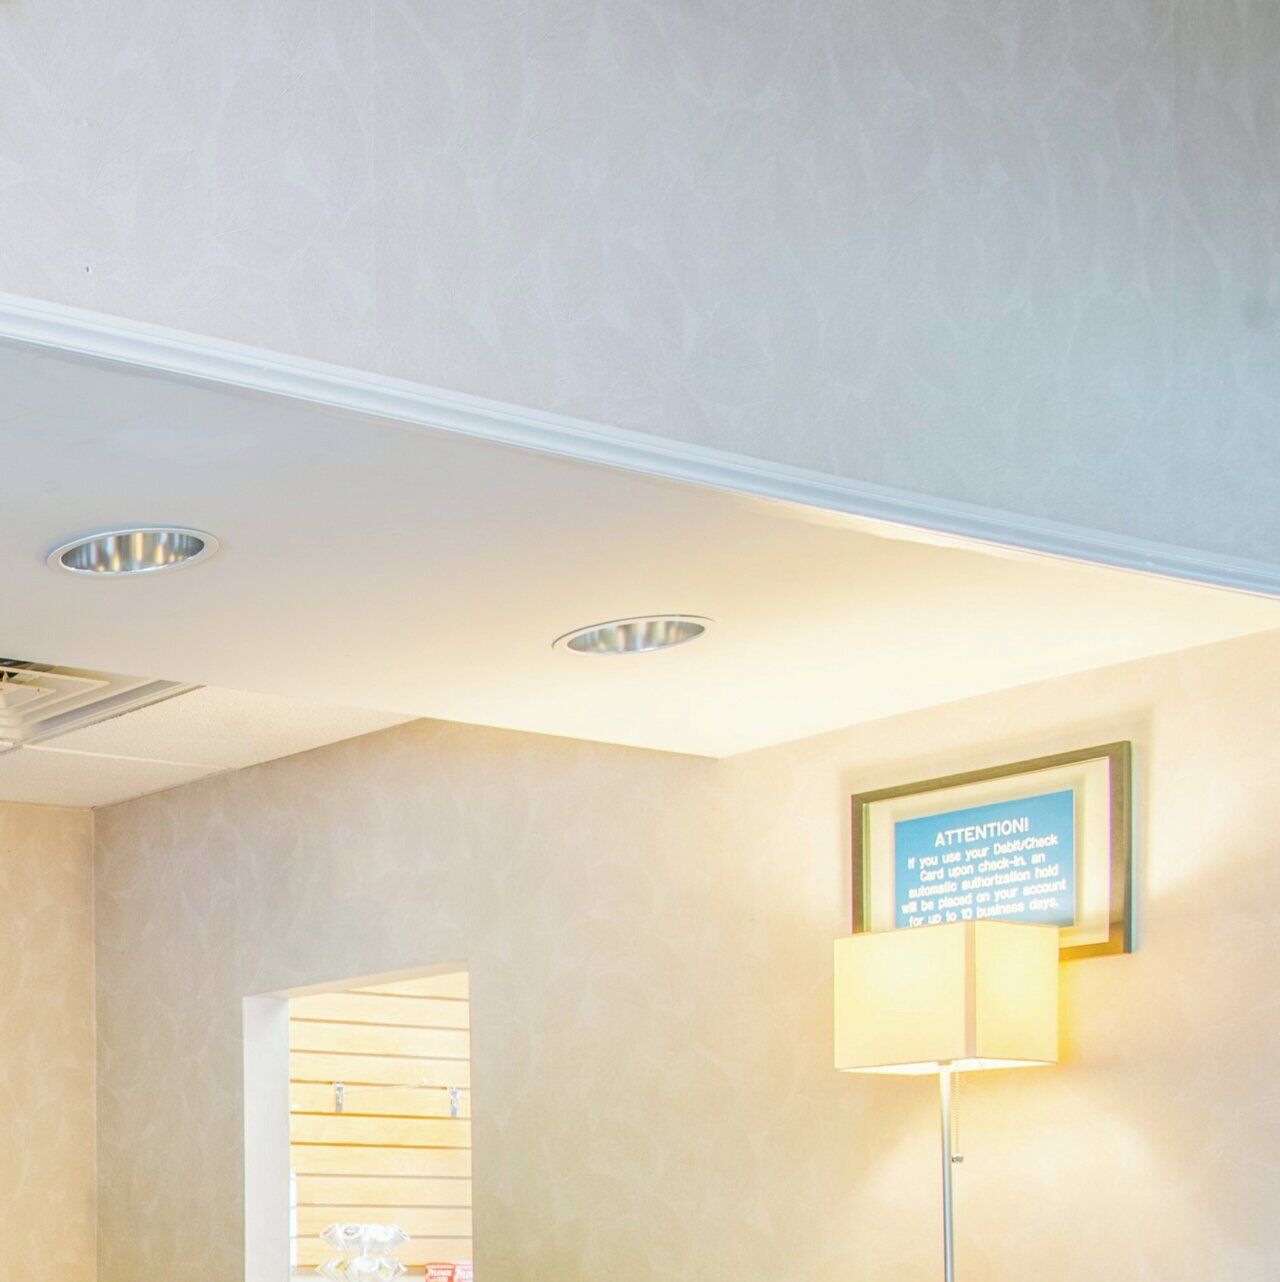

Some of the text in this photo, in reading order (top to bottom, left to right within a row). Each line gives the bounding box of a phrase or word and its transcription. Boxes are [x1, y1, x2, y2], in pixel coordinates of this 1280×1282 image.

[935, 817, 1029, 847] ATTENTION!
[908, 834, 1058, 869] If you use your Debit/Check
[920, 867, 944, 881] Card
[948, 864, 973, 877] upon
[1031, 853, 1045, 864] an
[902, 879, 1066, 914] will be placed on your account
[908, 864, 1059, 898] automatic authorization hold
[909, 915, 924, 927] for
[946, 911, 956, 922] to
[961, 908, 972, 920] 10
[977, 901, 1025, 918] business
